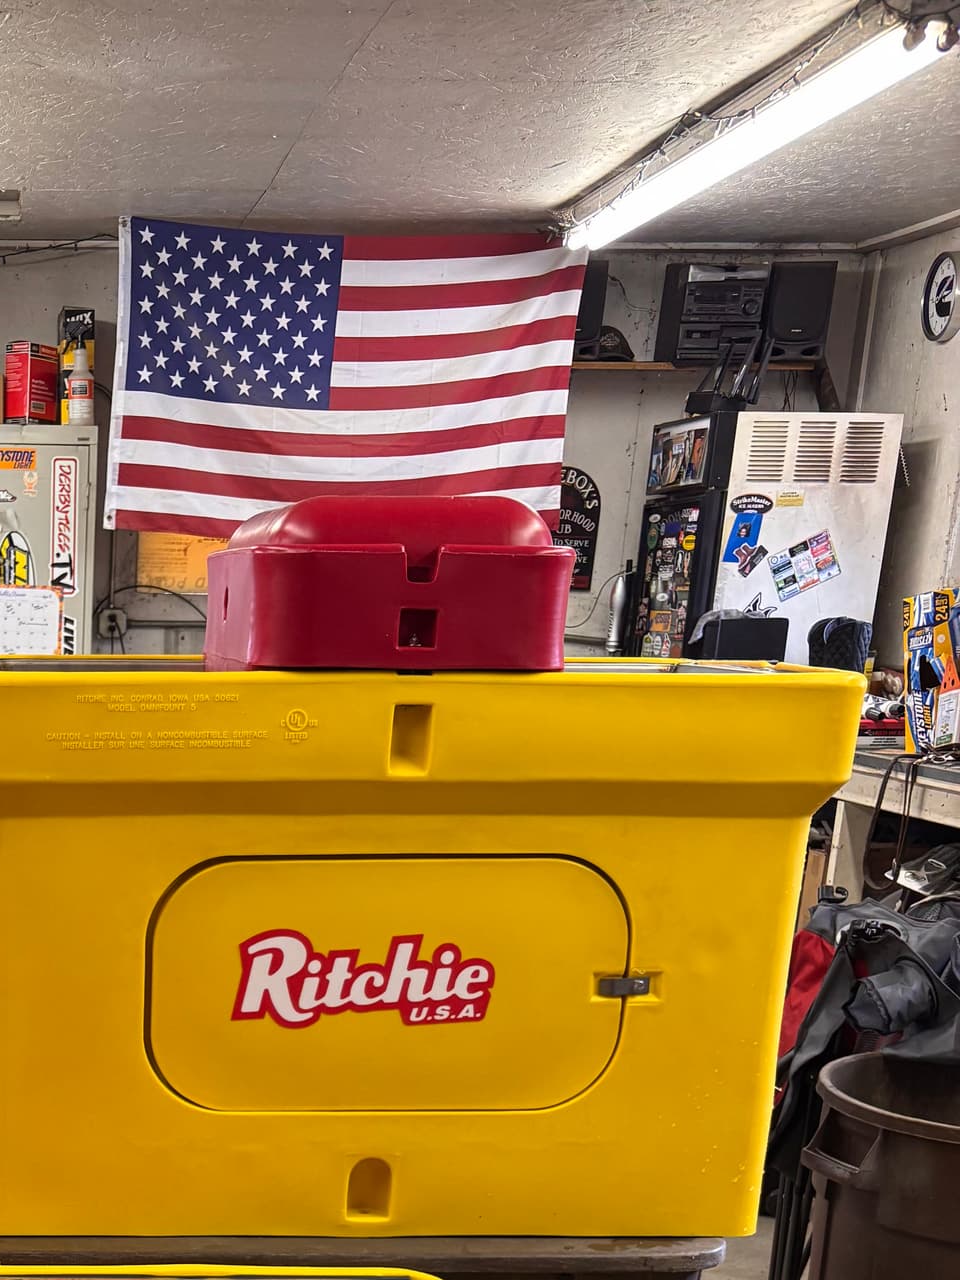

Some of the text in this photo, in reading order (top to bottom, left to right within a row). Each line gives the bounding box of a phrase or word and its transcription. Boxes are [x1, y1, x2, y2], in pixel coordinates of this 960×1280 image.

[732, 496, 771, 506] StrikeMaster
[924, 705, 932, 729] LIGHT
[47, 732, 81, 742] CAUTION
[94, 731, 126, 741] INSTALL
[240, 935, 489, 1022] Ritchie
[409, 1003, 481, 1022] U.S.A.
